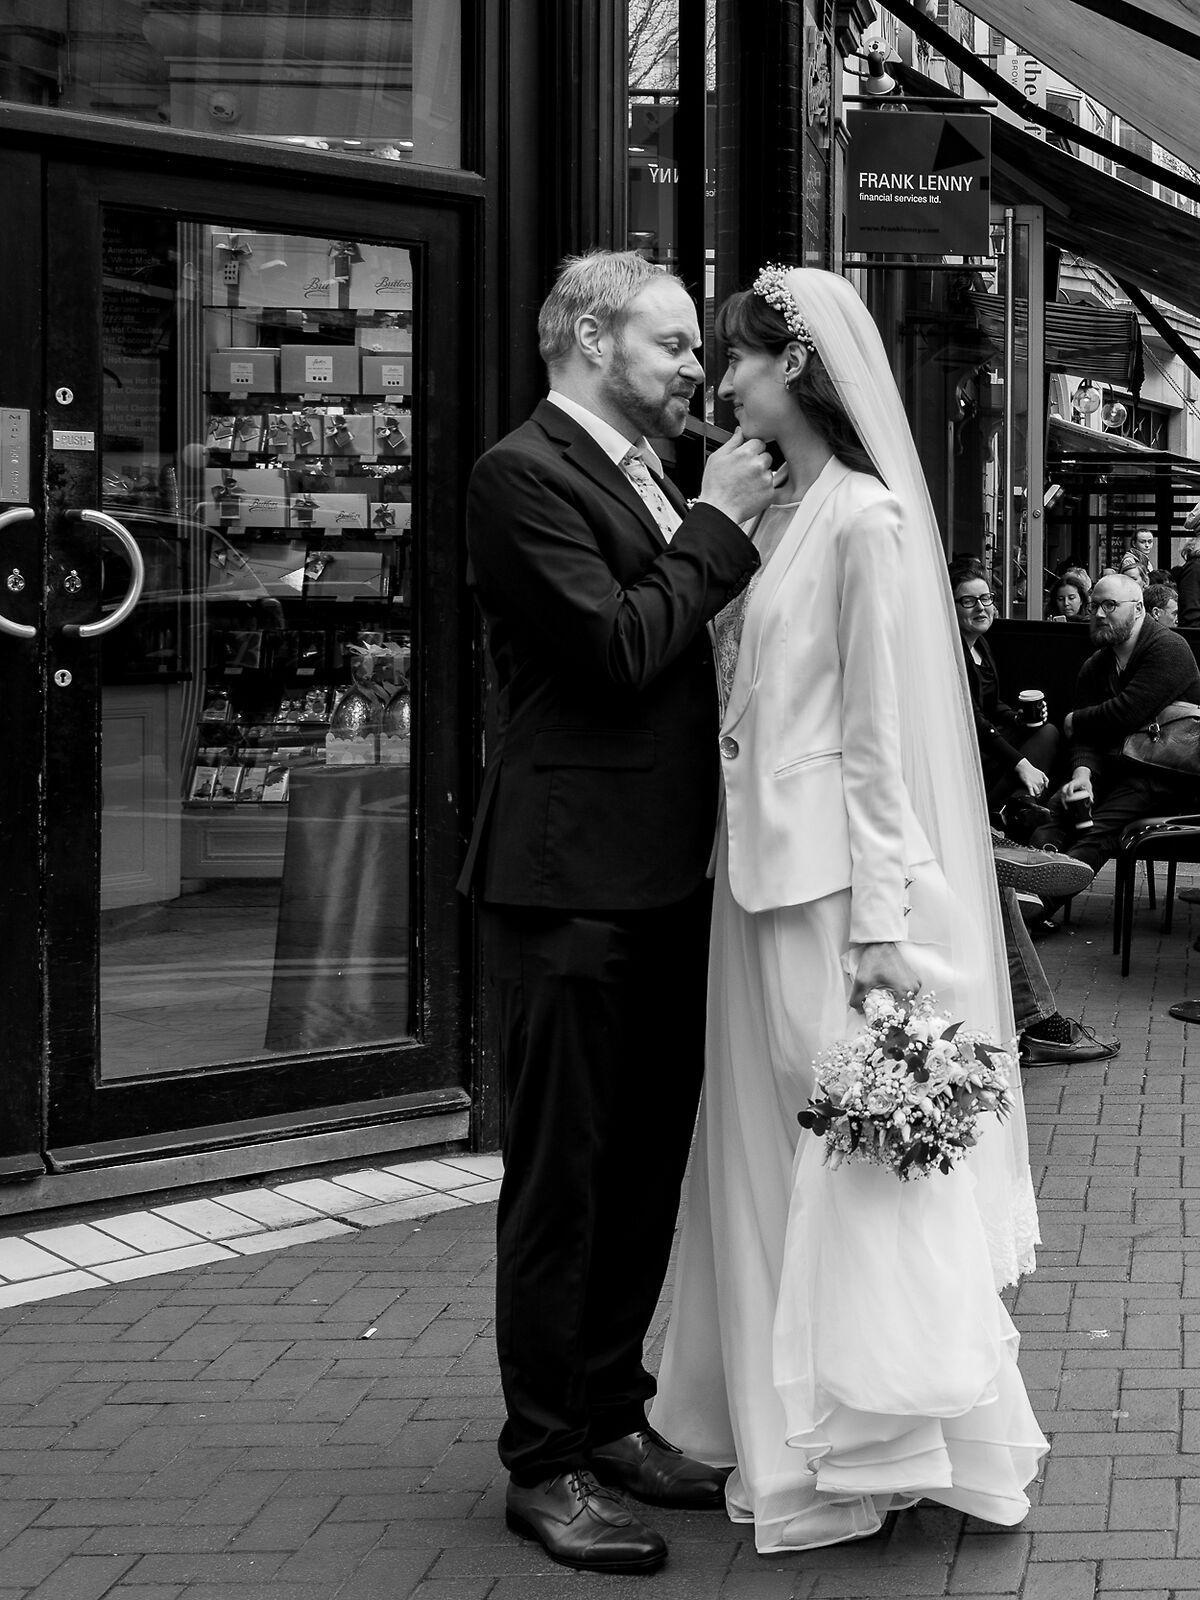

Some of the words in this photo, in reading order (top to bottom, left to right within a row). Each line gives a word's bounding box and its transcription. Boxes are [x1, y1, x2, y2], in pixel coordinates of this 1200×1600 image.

[859, 172, 915, 190] FRANK
[919, 175, 973, 192] LENNY
[859, 192, 893, 202] financial
[894, 194, 927, 204] services
[928, 194, 942, 204] ltd.
[61, 435, 87, 446] PUSH
